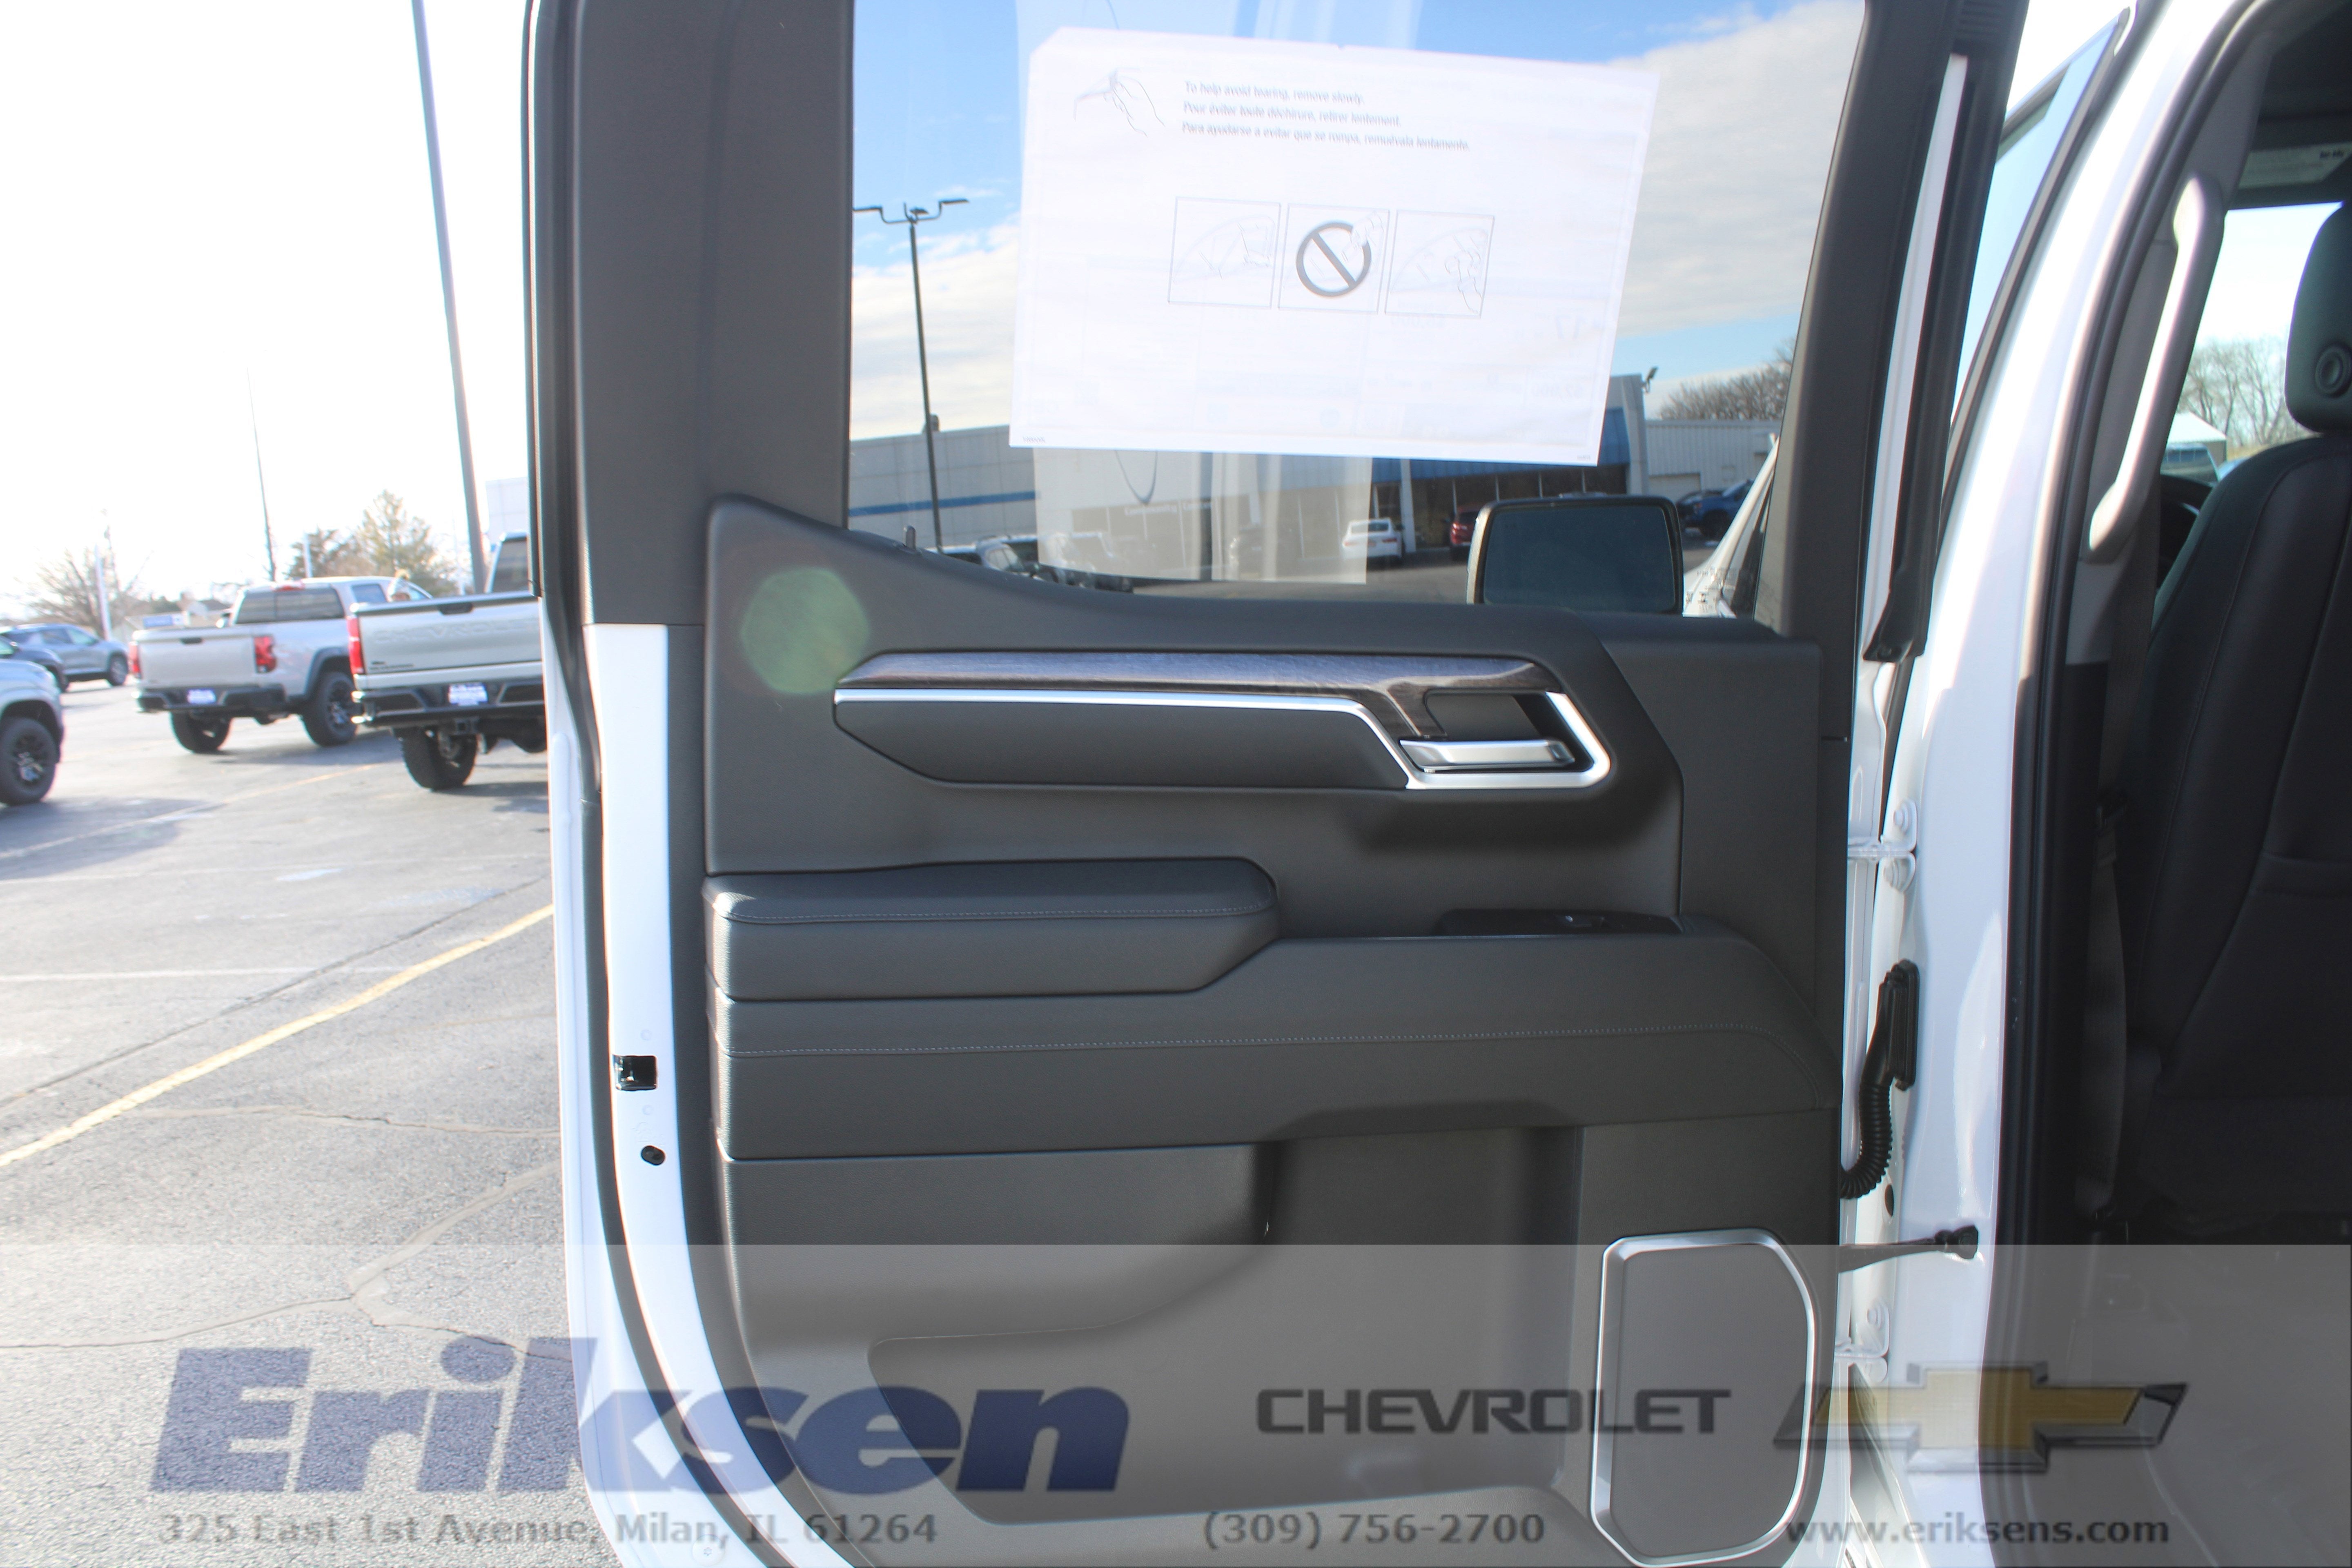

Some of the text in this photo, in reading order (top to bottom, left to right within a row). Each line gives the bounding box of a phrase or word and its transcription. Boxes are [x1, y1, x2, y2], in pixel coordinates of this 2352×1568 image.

[1185, 81, 1197, 94] To
[1200, 82, 1221, 97] help
[1224, 83, 1251, 97] avoid
[1254, 85, 1290, 102] tearing,
[1293, 89, 1329, 102] remove
[1184, 100, 1206, 115] Pour
[1240, 105, 1265, 118] toute
[1319, 109, 1348, 124] retirer
[1182, 121, 1205, 135] Para
[1254, 126, 1262, 138] a
[1263, 127, 1290, 139] evitar
[1294, 129, 1312, 143] que
[1314, 131, 1327, 142] se
